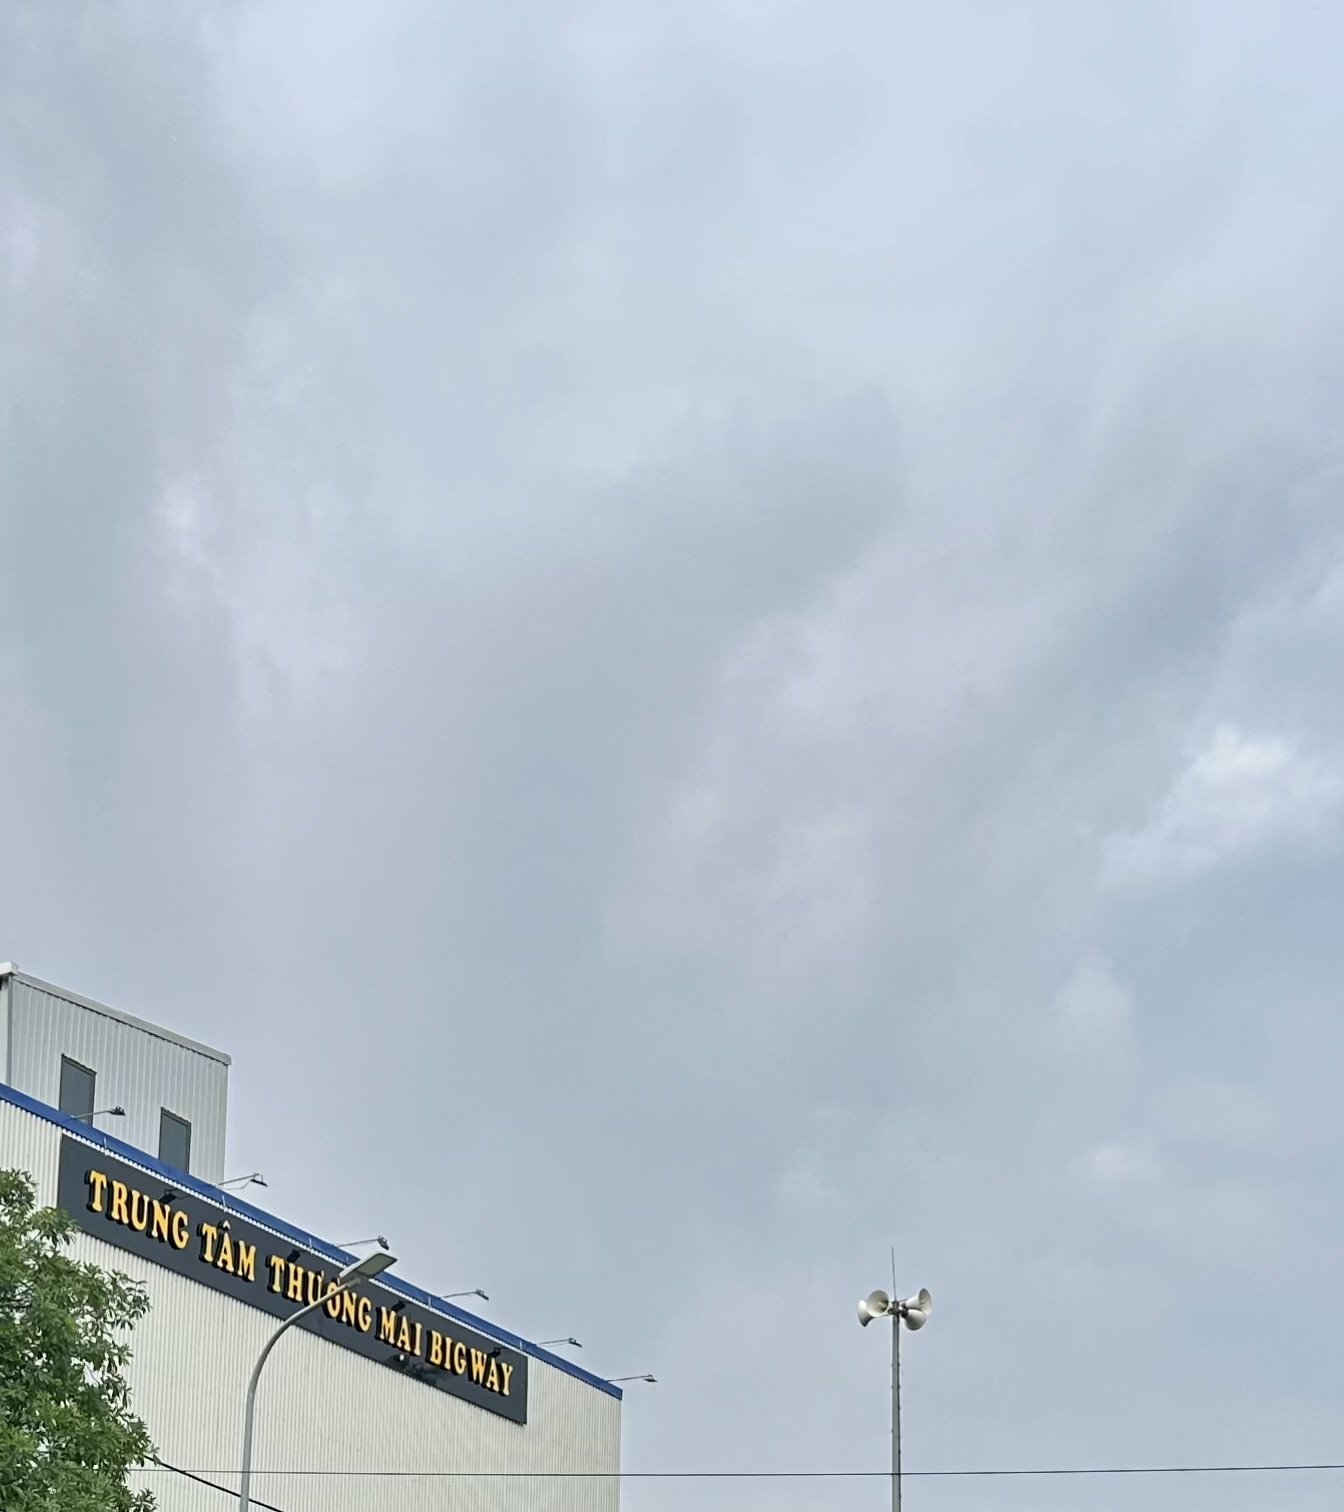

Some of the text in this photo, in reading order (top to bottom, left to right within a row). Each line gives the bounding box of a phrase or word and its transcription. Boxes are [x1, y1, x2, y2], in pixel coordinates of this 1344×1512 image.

[84, 1169, 514, 1398] TRUNG TÂM THƯƠNG MẠI BIGWAY
